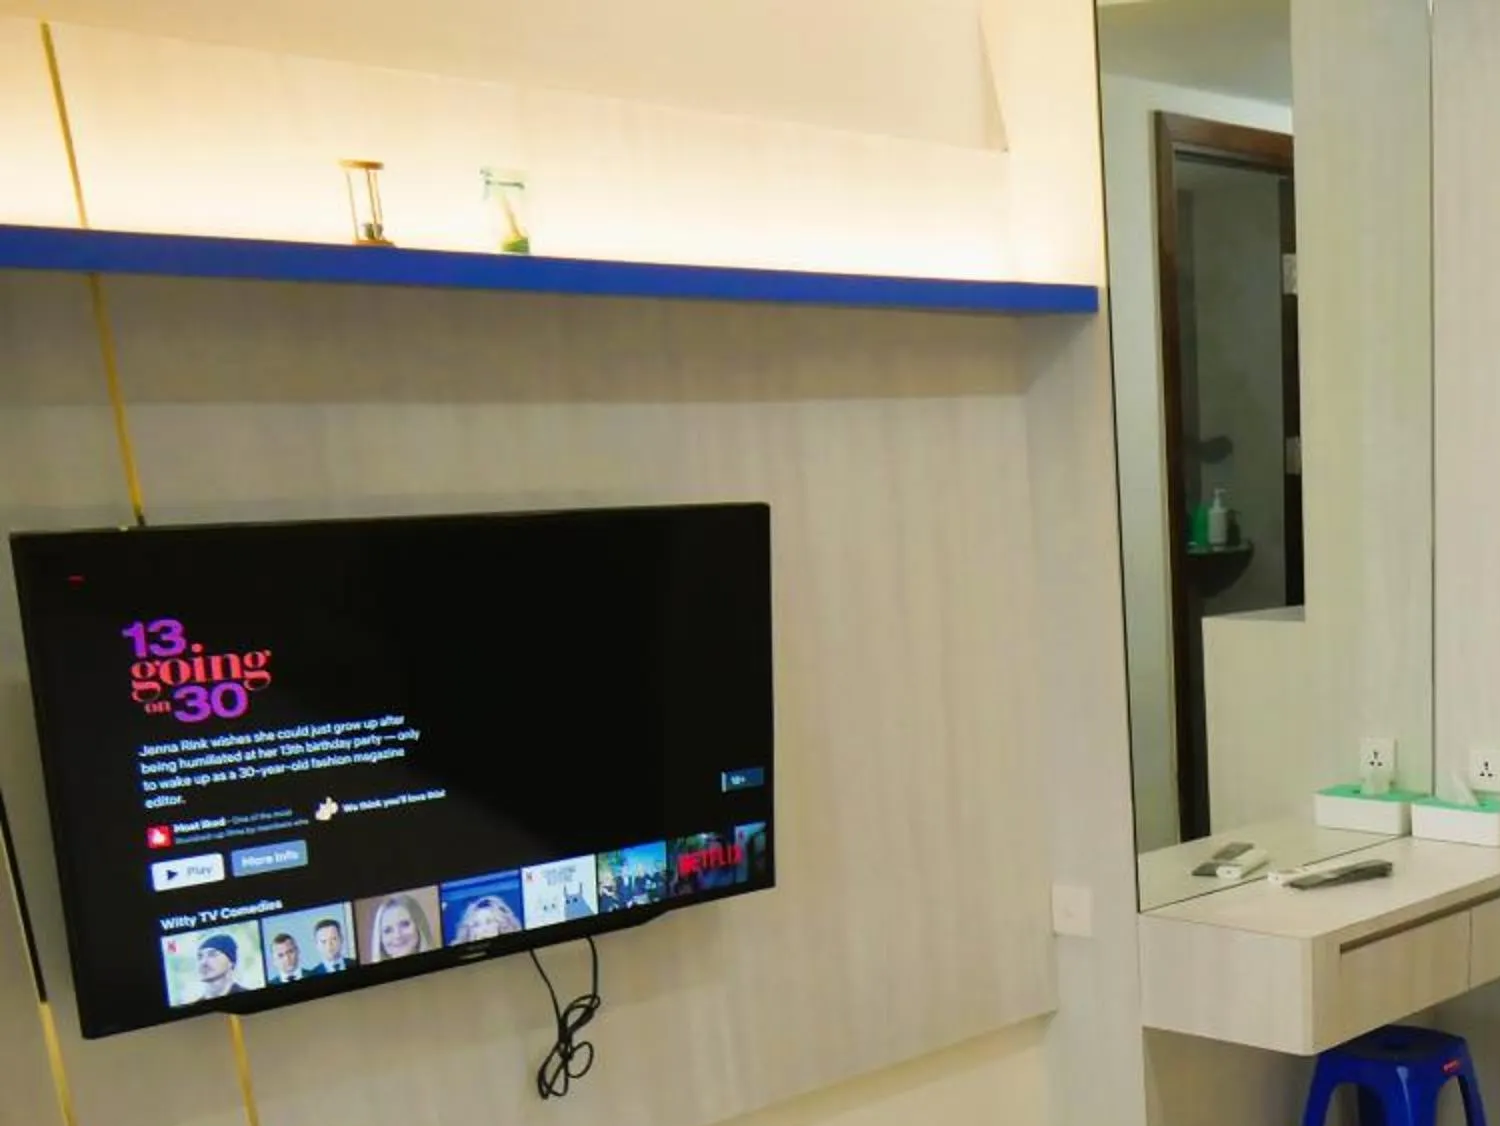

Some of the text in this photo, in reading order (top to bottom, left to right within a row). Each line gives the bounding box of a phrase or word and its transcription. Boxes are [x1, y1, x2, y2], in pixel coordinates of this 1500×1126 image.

[121, 618, 187, 659] 13
[130, 643, 272, 702] going
[144, 682, 248, 722] on 30
[138, 714, 405, 757] Jenna Rink wishes she could just grow up after
[140, 760, 177, 775] being
[178, 750, 243, 769] humiliated
[244, 749, 257, 761] at
[258, 747, 278, 759] her
[279, 743, 305, 756] 13th
[305, 737, 351, 753] birthday
[352, 734, 381, 749] party
[397, 729, 420, 741] only
[142, 747, 405, 791] to wake up as a 30-year-old fashion magazine
[144, 794, 187, 809] editor.
[186, 865, 213, 878] Play
[241, 853, 274, 868] More
[160, 899, 284, 931] Witty TV Comedies
